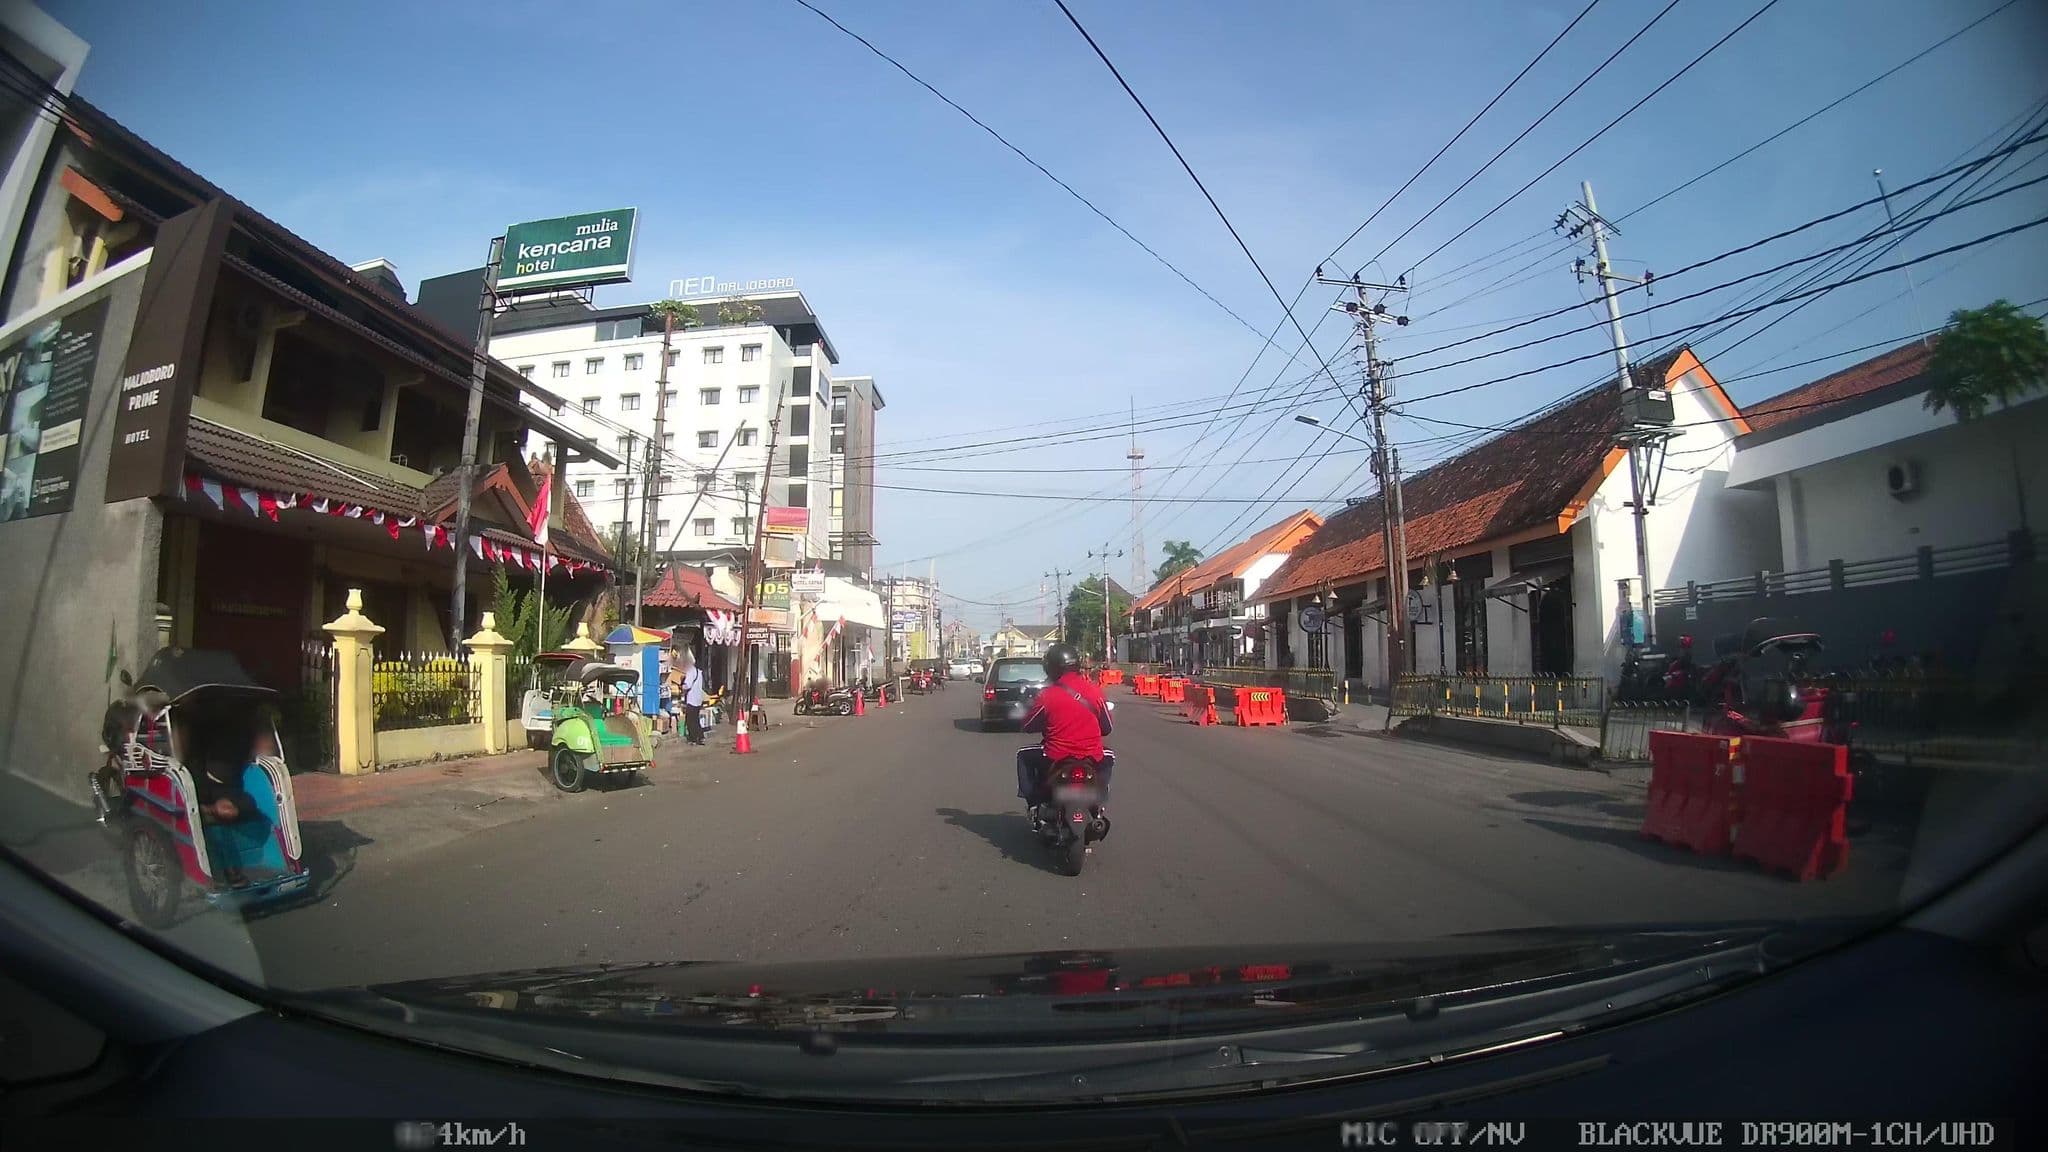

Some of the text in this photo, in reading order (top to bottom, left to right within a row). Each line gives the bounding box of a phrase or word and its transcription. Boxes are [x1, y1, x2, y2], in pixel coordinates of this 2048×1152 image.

[575, 217, 619, 236] mulia
[518, 235, 612, 260] kencana
[515, 257, 556, 275] hotel
[123, 363, 175, 392] MALIOBORO
[128, 389, 160, 411] PRIME
[124, 429, 151, 444] HOTEL
[755, 583, 789, 595] 105
